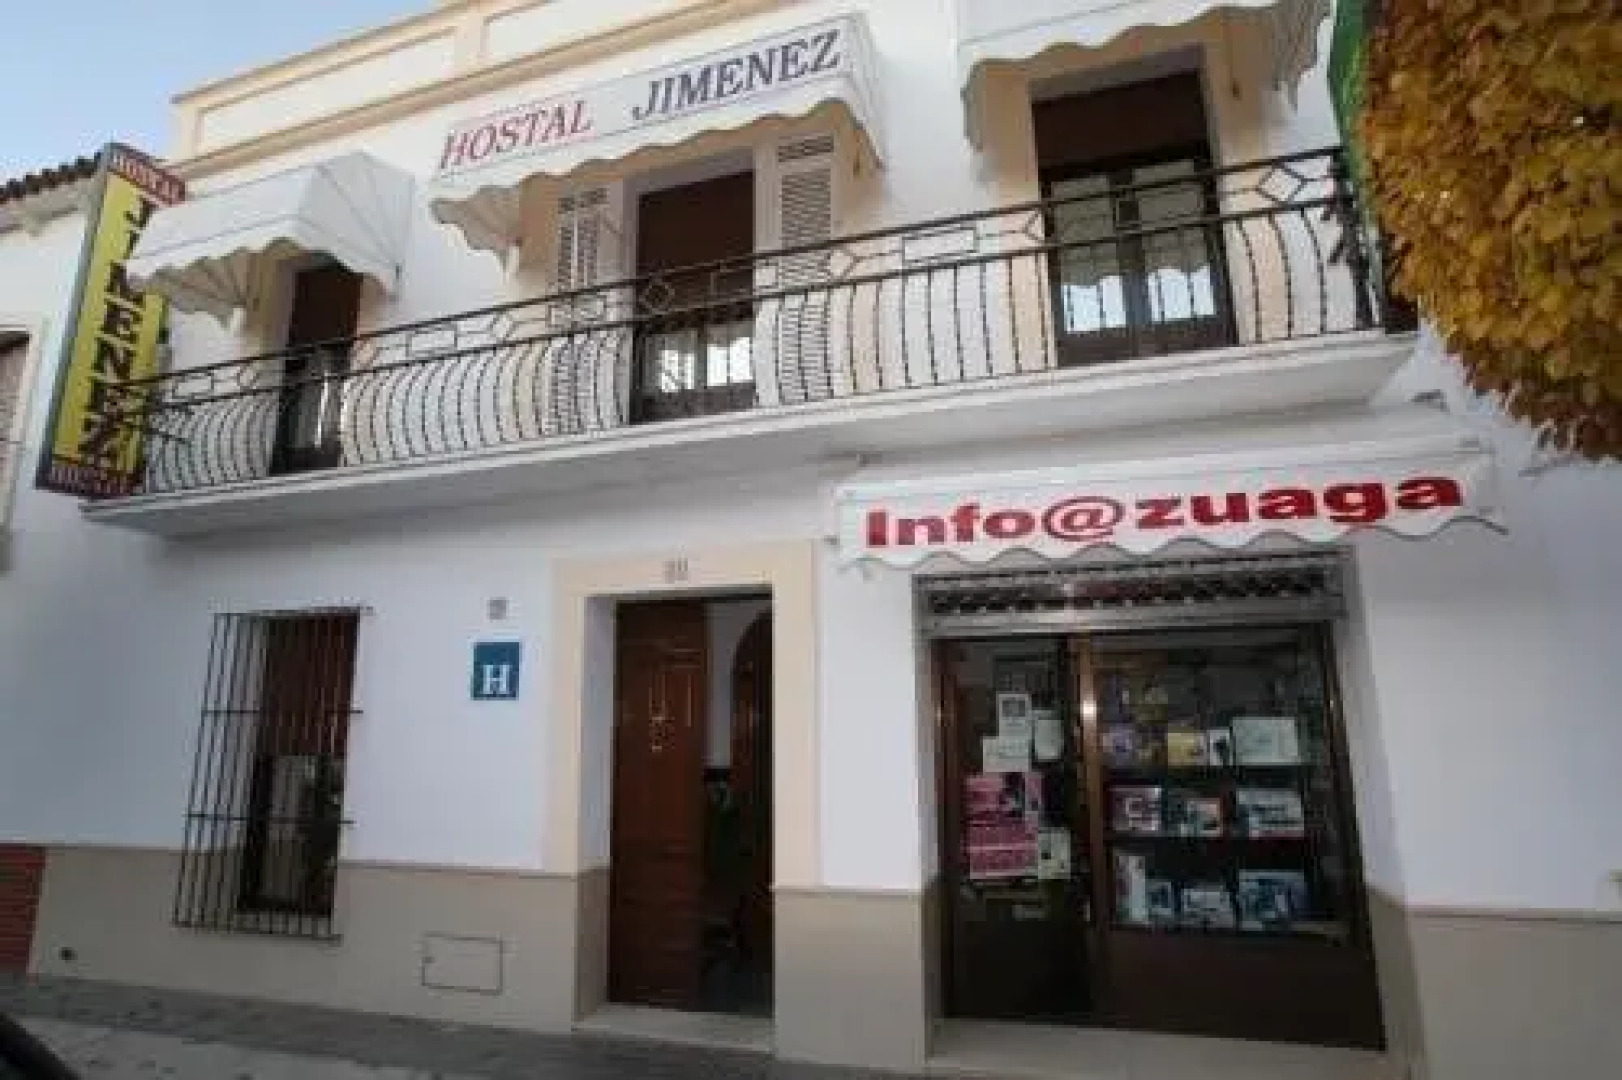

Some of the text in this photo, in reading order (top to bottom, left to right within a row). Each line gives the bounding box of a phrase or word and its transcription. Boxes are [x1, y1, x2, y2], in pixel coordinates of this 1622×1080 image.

[438, 29, 840, 170] HOSTAL JIMENEZ
[865, 476, 1463, 547] Info@zuaga
[482, 664, 510, 695] H
